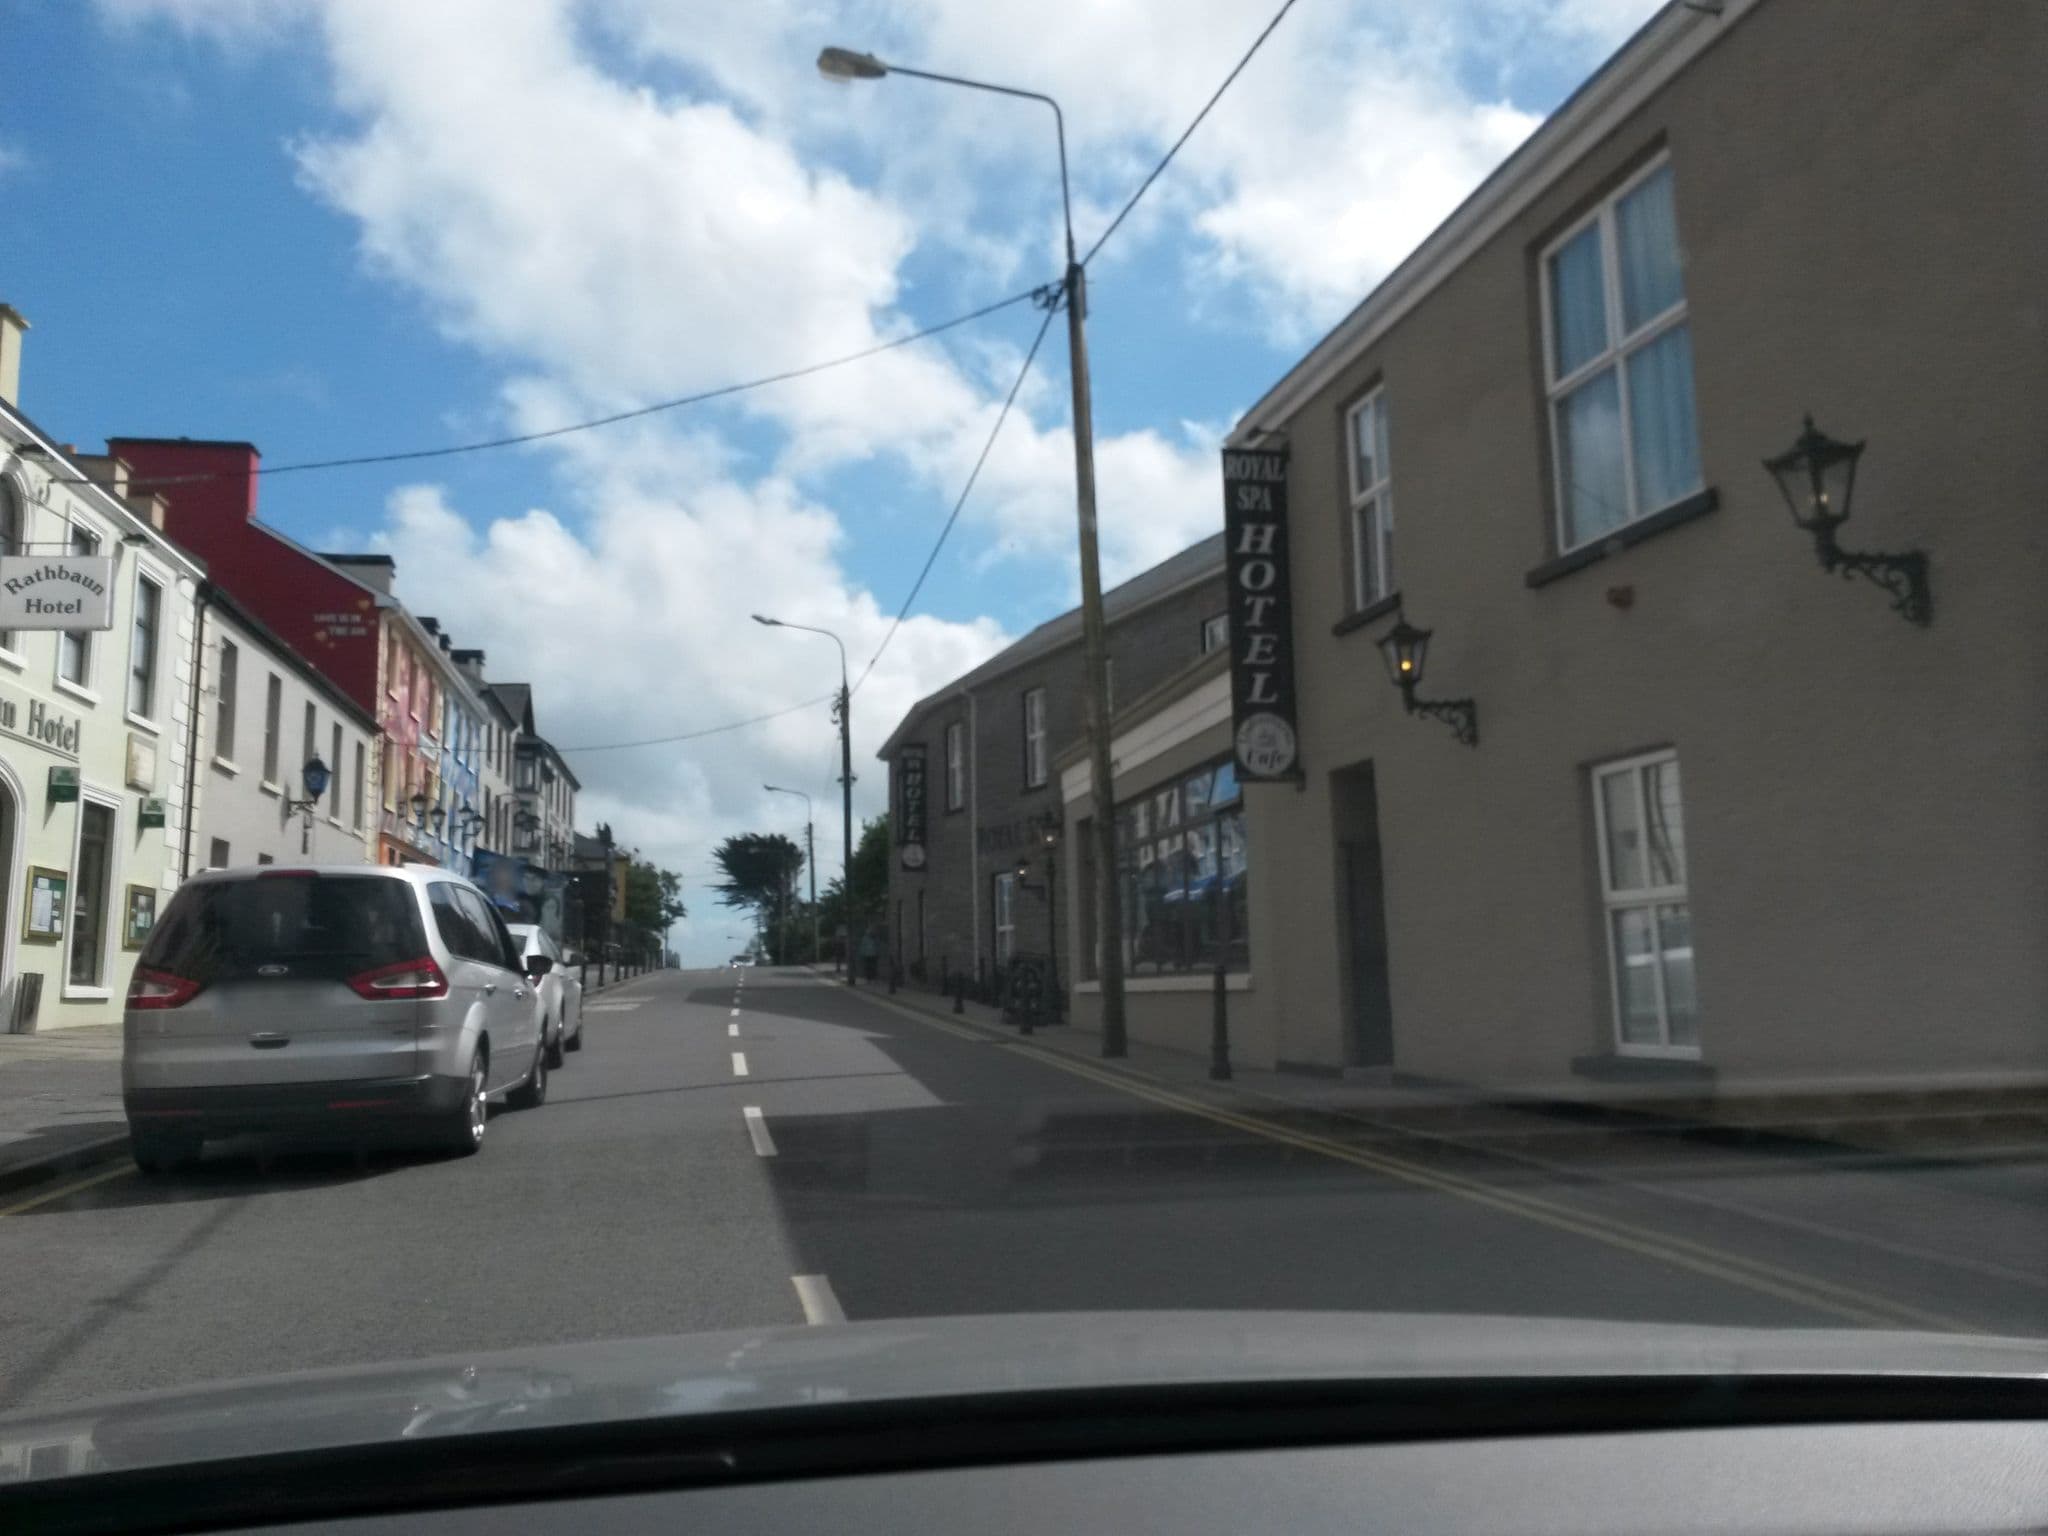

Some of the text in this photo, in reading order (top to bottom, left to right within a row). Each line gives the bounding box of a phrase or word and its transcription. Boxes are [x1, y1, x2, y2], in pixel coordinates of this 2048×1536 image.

[1225, 456, 1284, 482] ROYAL
[1237, 485, 1272, 511] SPA
[4, 565, 104, 595] Rathbaun
[25, 598, 82, 614] Hotel
[1235, 523, 1279, 704] HOTEL
[27, 698, 81, 754] Hotel
